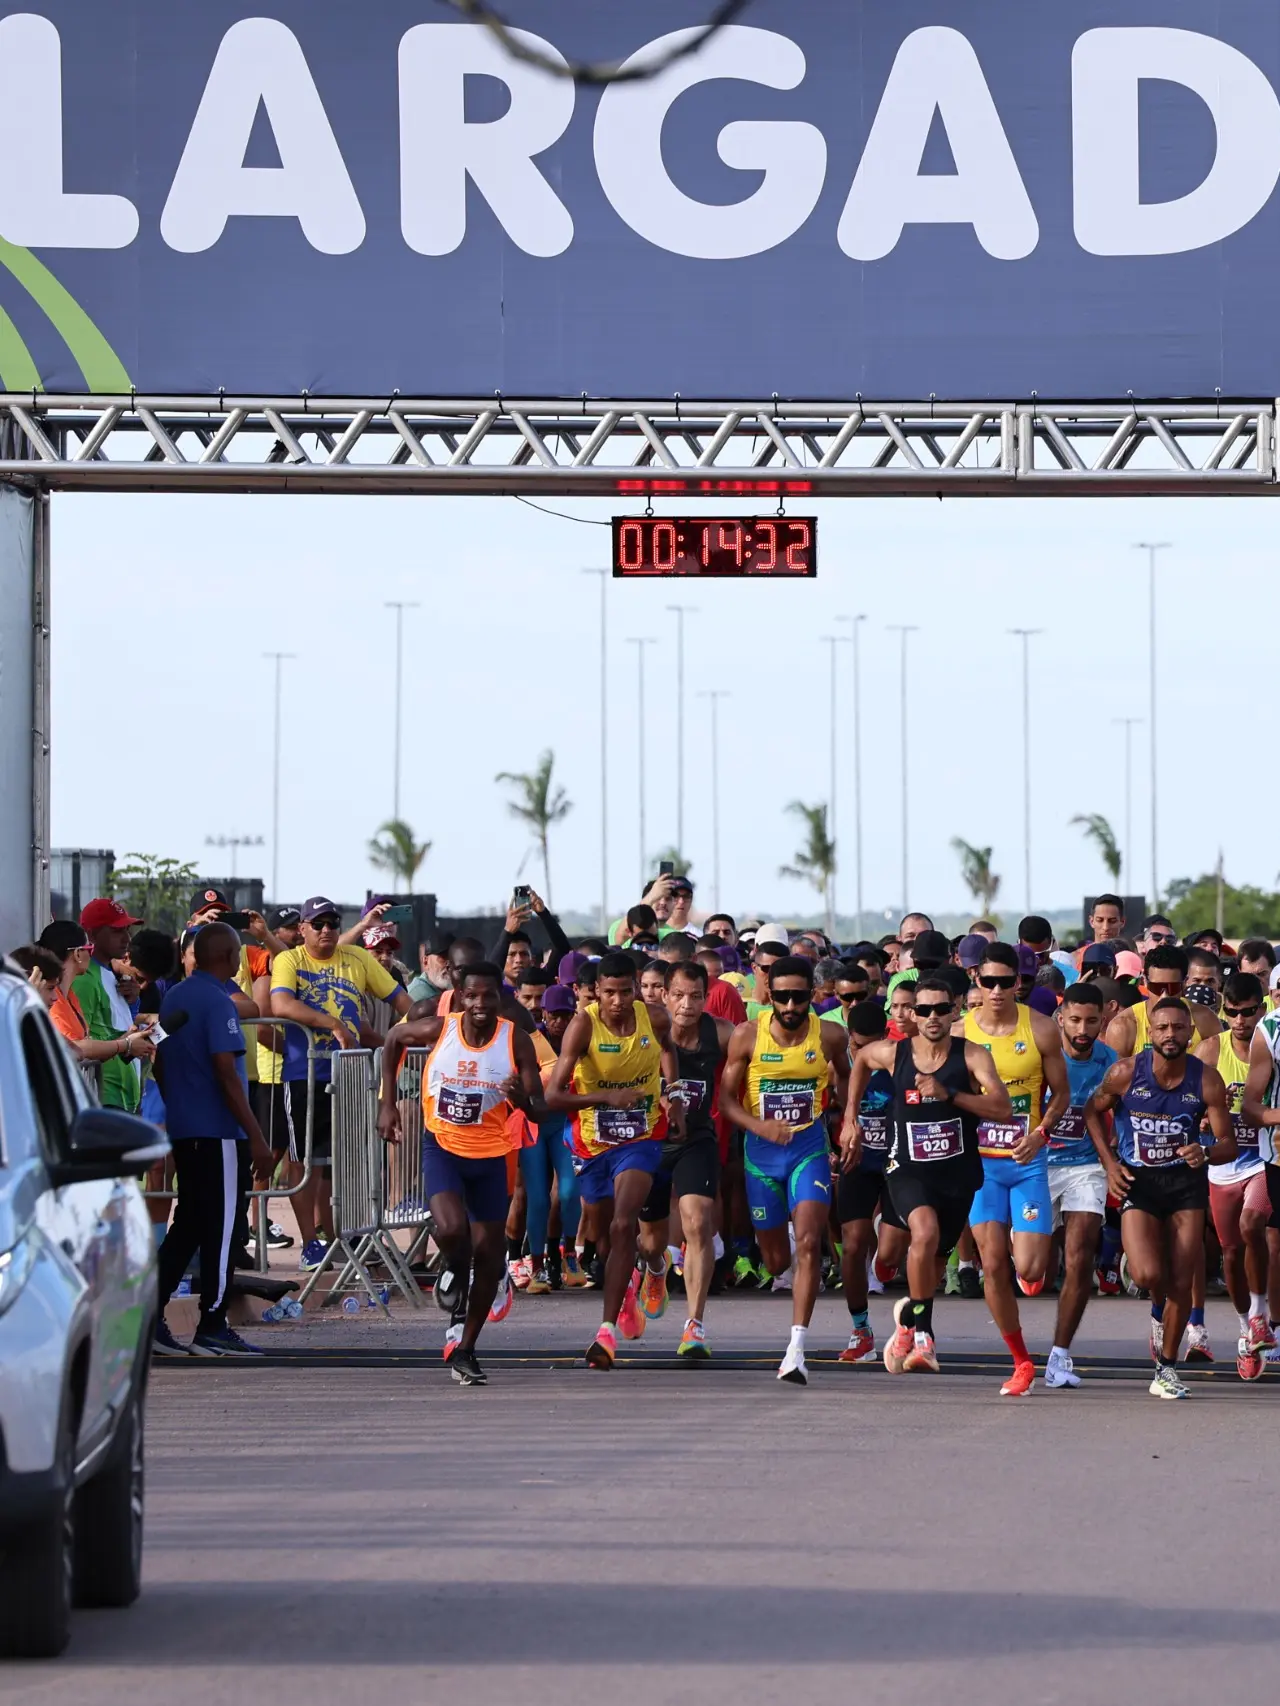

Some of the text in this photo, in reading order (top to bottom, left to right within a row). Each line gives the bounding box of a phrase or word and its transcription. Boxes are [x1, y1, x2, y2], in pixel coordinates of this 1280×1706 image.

[620, 523, 809, 570] 00:14:32
[457, 1060, 478, 1073] 52
[447, 1105, 473, 1118] 033
[774, 1108, 801, 1121] 010
[922, 1139, 950, 1152] 020
[1147, 1148, 1173, 1159] 006
